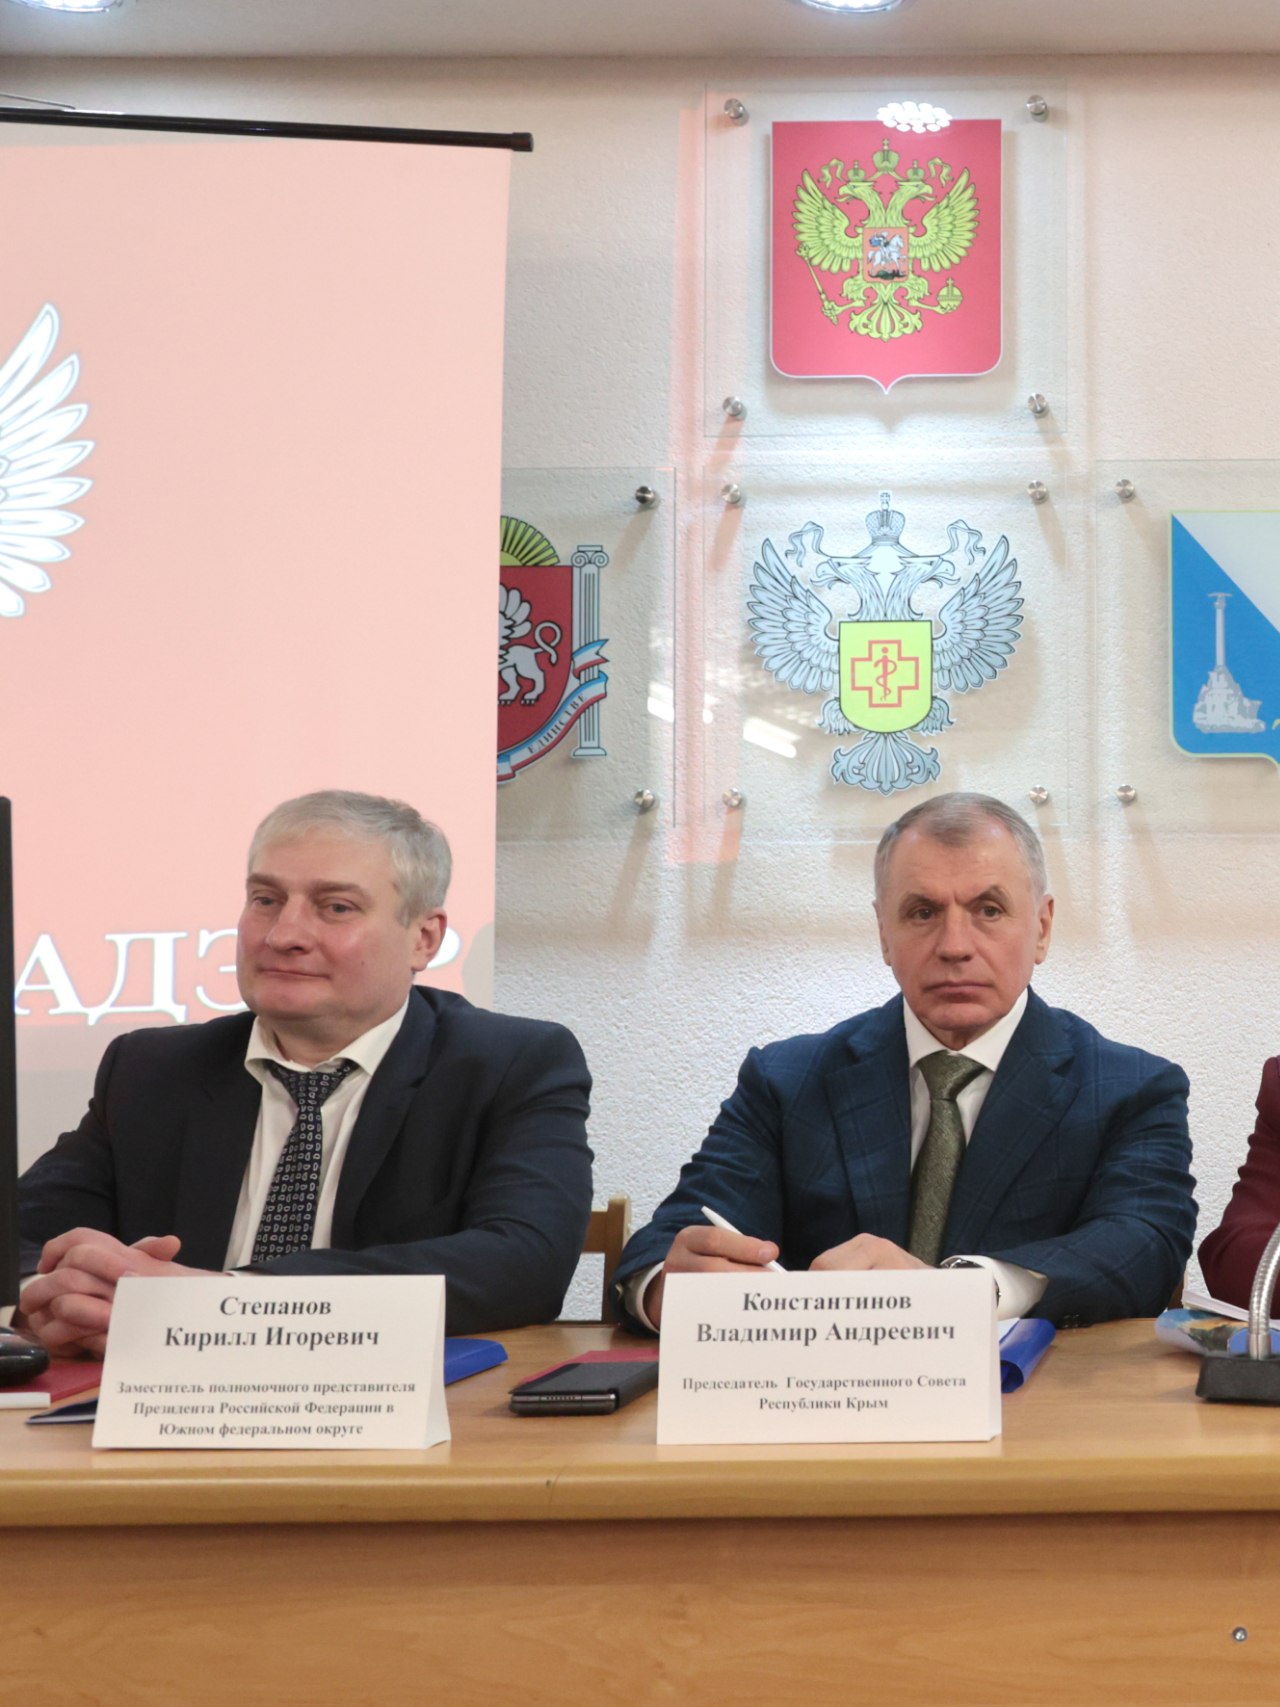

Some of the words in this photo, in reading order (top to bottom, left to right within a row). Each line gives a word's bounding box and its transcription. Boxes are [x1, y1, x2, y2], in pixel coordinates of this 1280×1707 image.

[219, 1295, 332, 1317] Степанов
[742, 1292, 912, 1312] Константинов
[164, 1326, 257, 1353] Кирилл
[264, 1325, 380, 1352] Игоревич
[696, 1322, 818, 1348] Владимир
[824, 1321, 955, 1347] Андреевич
[119, 1381, 205, 1394] Заместитель
[208, 1383, 310, 1394] полномочного
[312, 1383, 416, 1397] представителя
[682, 1377, 779, 1393] Председатель
[786, 1376, 914, 1392] Государственного
[916, 1375, 967, 1388] Совета
[133, 1401, 215, 1418] Президента
[219, 1401, 301, 1415] Российской
[303, 1401, 383, 1417] Федерации
[385, 1404, 395, 1414] в
[759, 1397, 842, 1413] Республики
[846, 1396, 889, 1413] Крым
[158, 1422, 216, 1436] Южном
[218, 1422, 312, 1439] федеральном
[315, 1424, 364, 1439] округе
